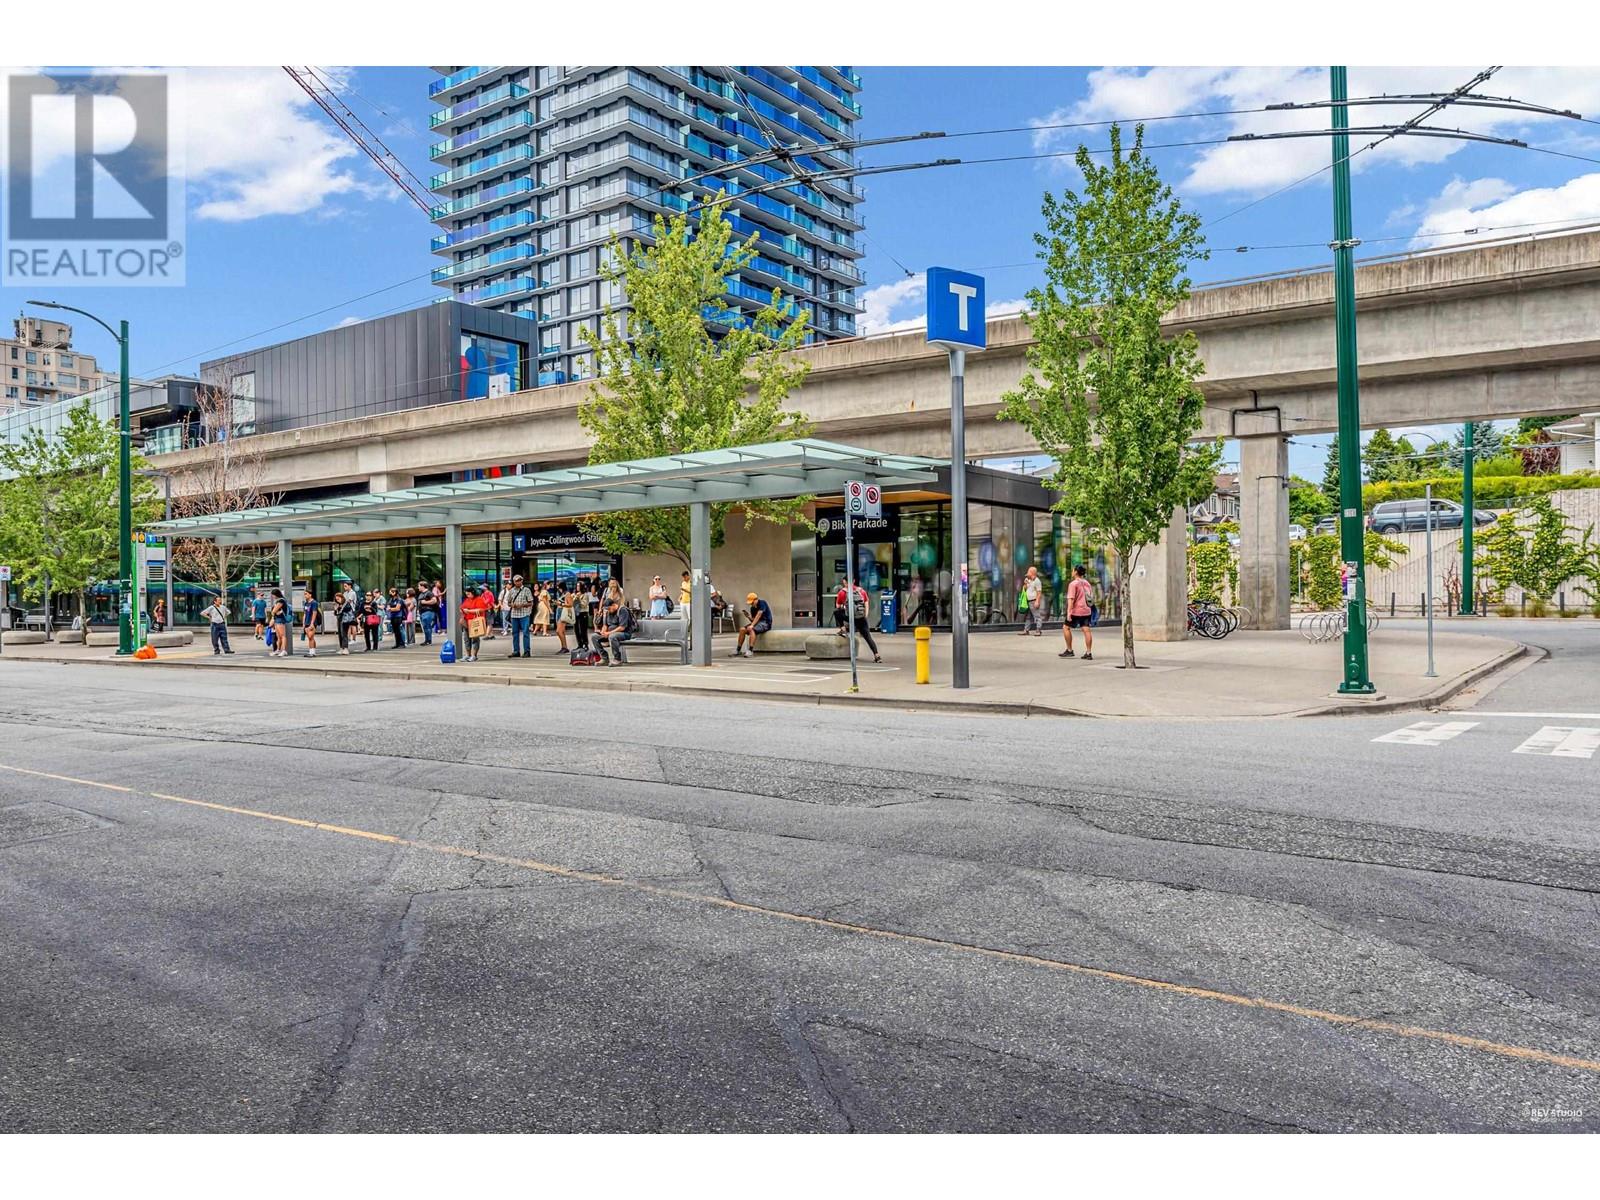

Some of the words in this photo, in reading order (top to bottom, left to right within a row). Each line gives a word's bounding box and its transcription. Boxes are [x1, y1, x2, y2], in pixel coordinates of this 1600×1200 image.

[949, 282, 977, 331] T
[831, 519, 846, 530] Bik
[852, 518, 888, 529] Parkade
[514, 538, 522, 548] T
